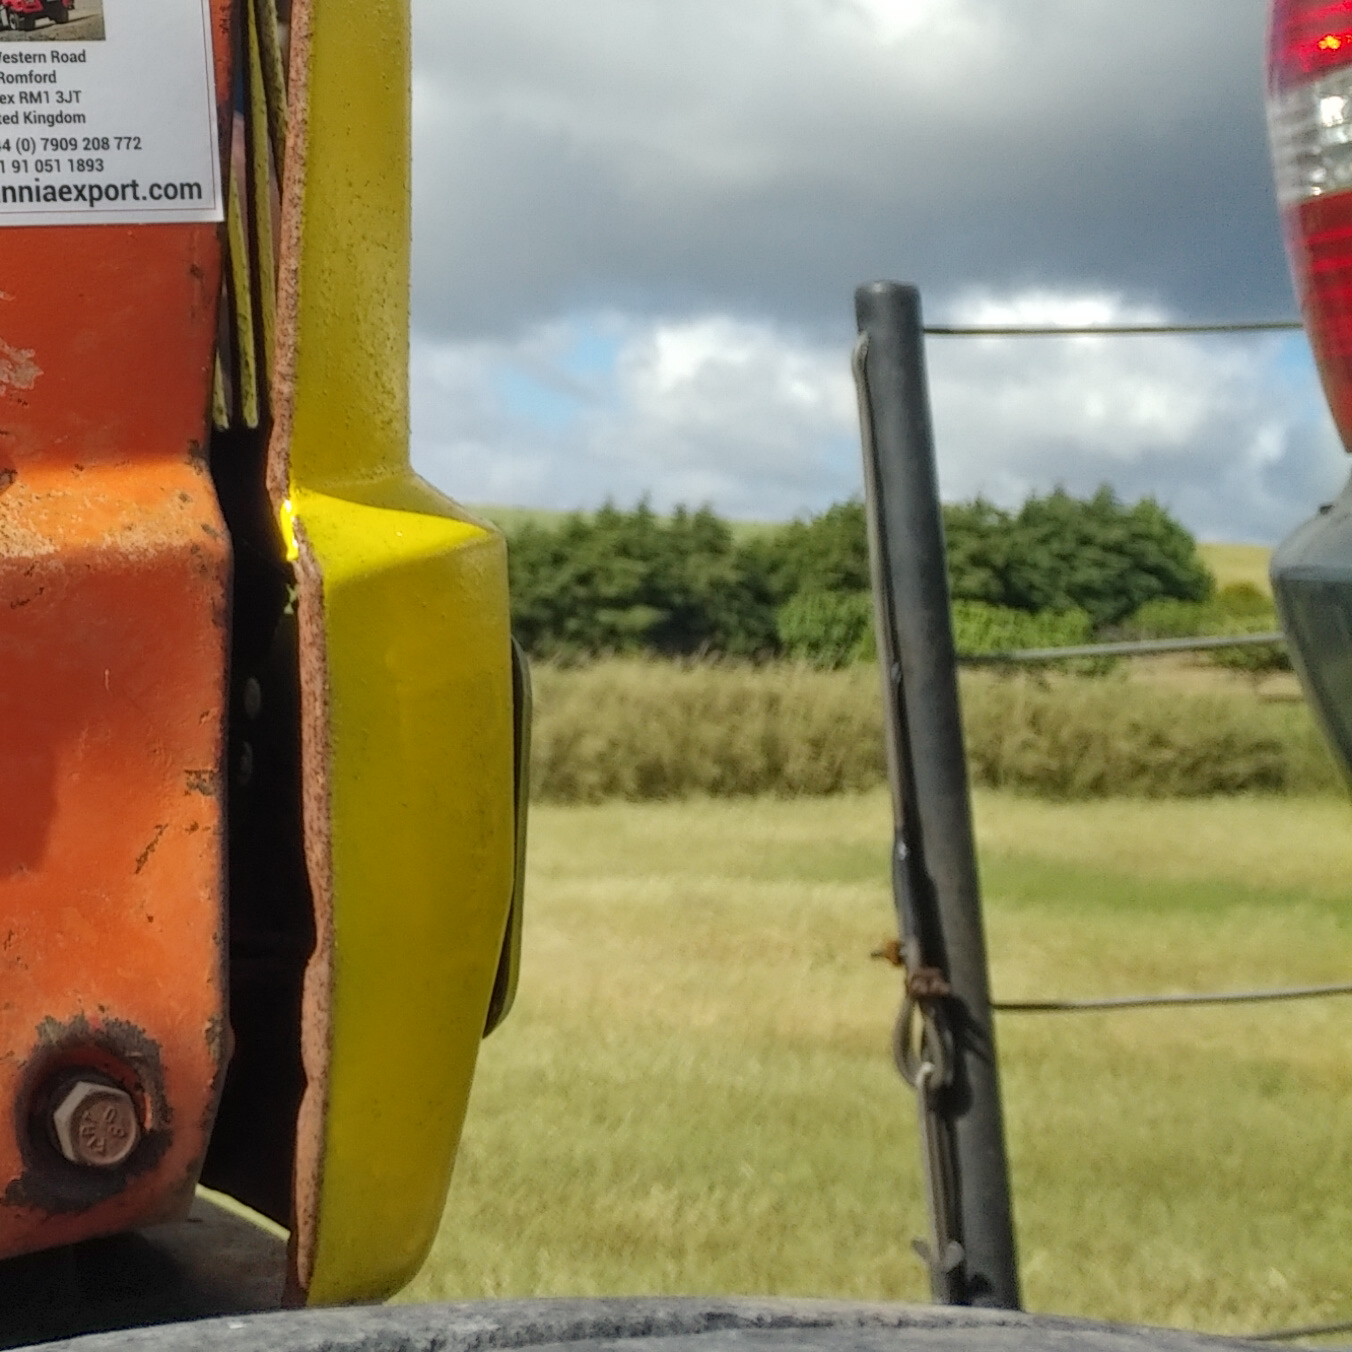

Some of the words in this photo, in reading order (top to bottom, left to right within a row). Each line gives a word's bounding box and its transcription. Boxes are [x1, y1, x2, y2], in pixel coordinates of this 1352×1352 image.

[51, 49, 86, 63] Road
[19, 91, 49, 104] RM1
[56, 90, 81, 103] 3JT
[23, 110, 86, 127] Kingdom
[16, 137, 36, 155] (0)
[41, 138, 77, 151] 7909
[83, 137, 110, 150] 208
[114, 137, 142, 150] 772
[12, 160, 28, 173] 91
[35, 159, 60, 173] 051
[68, 158, 104, 172] 1893
